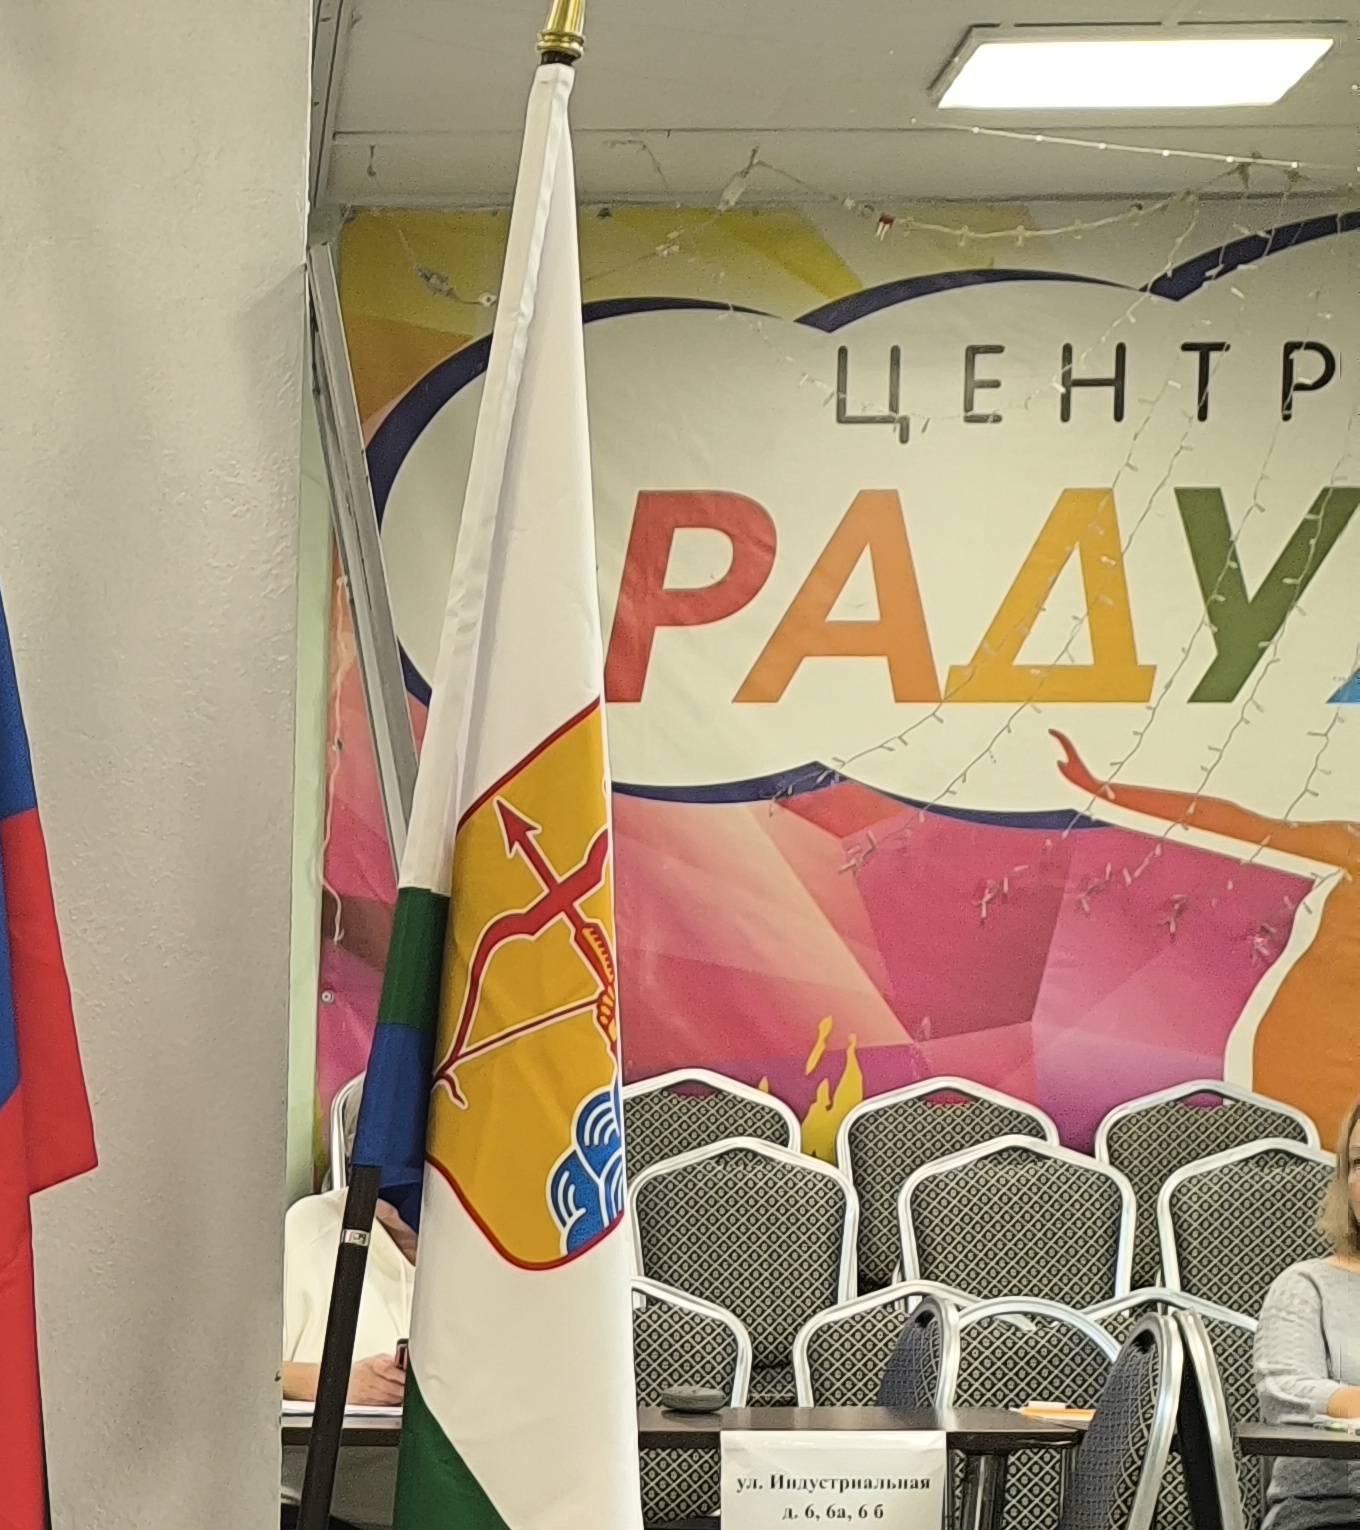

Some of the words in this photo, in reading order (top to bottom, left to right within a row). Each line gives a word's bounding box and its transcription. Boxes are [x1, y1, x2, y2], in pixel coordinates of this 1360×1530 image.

[836, 340, 1336, 444] ЦЕНТР
[604, 486, 1360, 704] РАДУ
[736, 1476, 764, 1493] ул.
[770, 1474, 931, 1493] Индустриальная
[782, 1507, 799, 1521] д.
[805, 1503, 821, 1521] 6,
[826, 1503, 853, 1521] 6а,
[858, 1503, 868, 1519] 6
